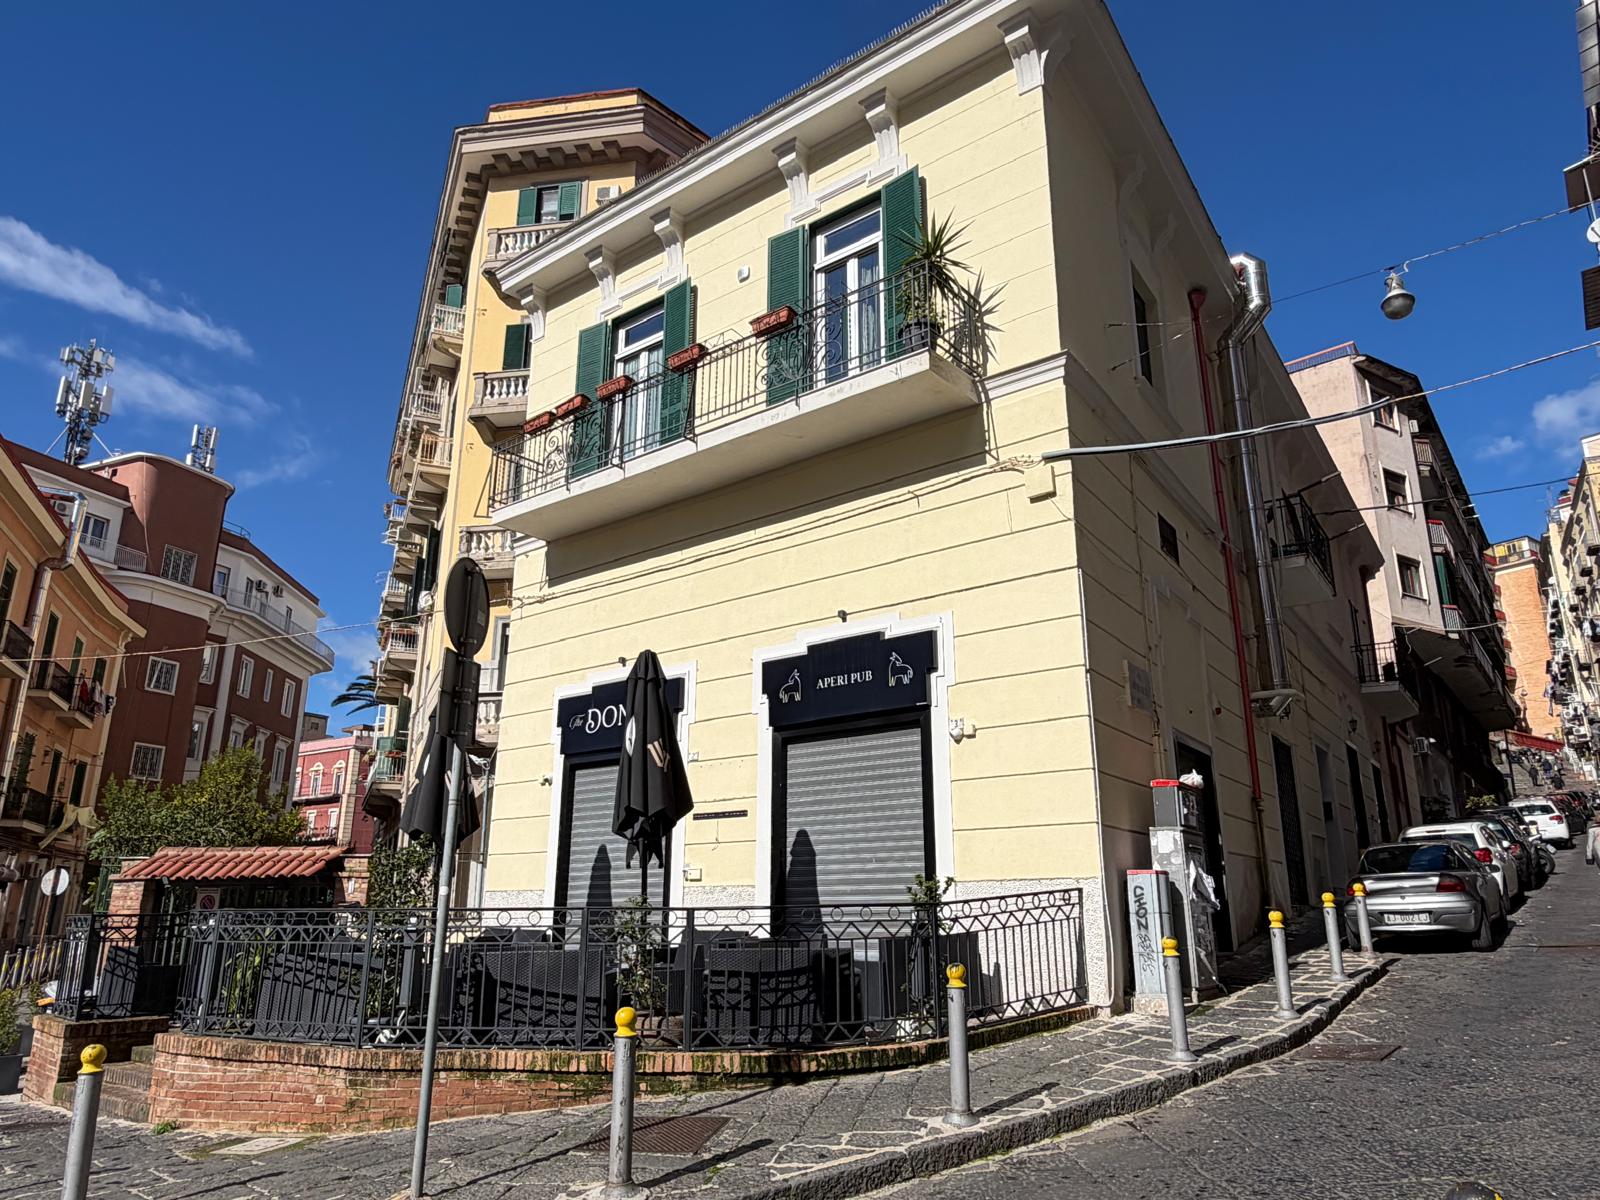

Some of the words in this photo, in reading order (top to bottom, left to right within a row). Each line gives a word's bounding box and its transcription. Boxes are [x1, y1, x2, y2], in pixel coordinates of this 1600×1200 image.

[816, 673, 848, 690] APERI
[850, 670, 873, 684] PUB
[569, 713, 586, 730] The
